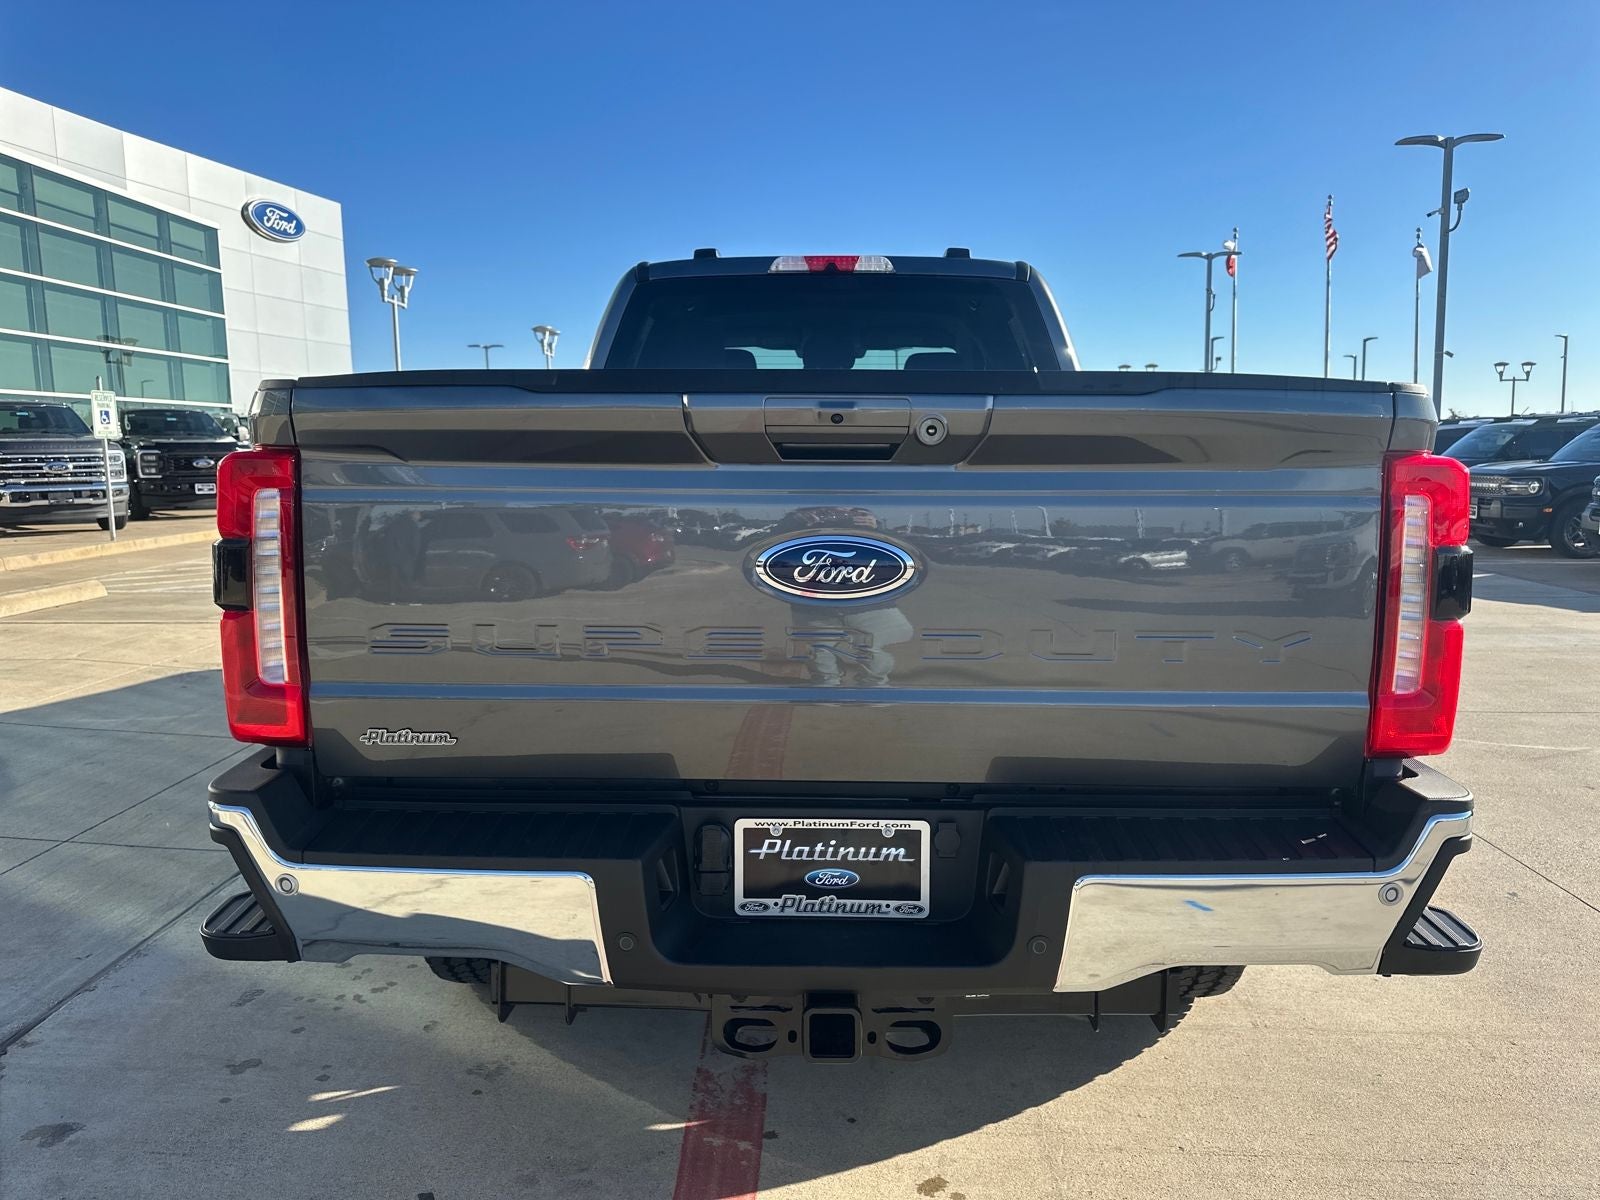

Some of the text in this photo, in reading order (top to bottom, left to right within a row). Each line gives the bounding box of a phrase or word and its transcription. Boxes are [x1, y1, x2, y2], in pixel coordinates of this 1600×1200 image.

[263, 207, 297, 235] Ford
[793, 549, 878, 584] Ford
[368, 622, 1314, 664] SUPER DUTY
[359, 727, 458, 746] Platinum
[754, 819, 912, 829] www.PlatinumFord.com
[748, 839, 916, 862] Platinum
[815, 872, 849, 885] Ford
[778, 895, 891, 914] Platinum
